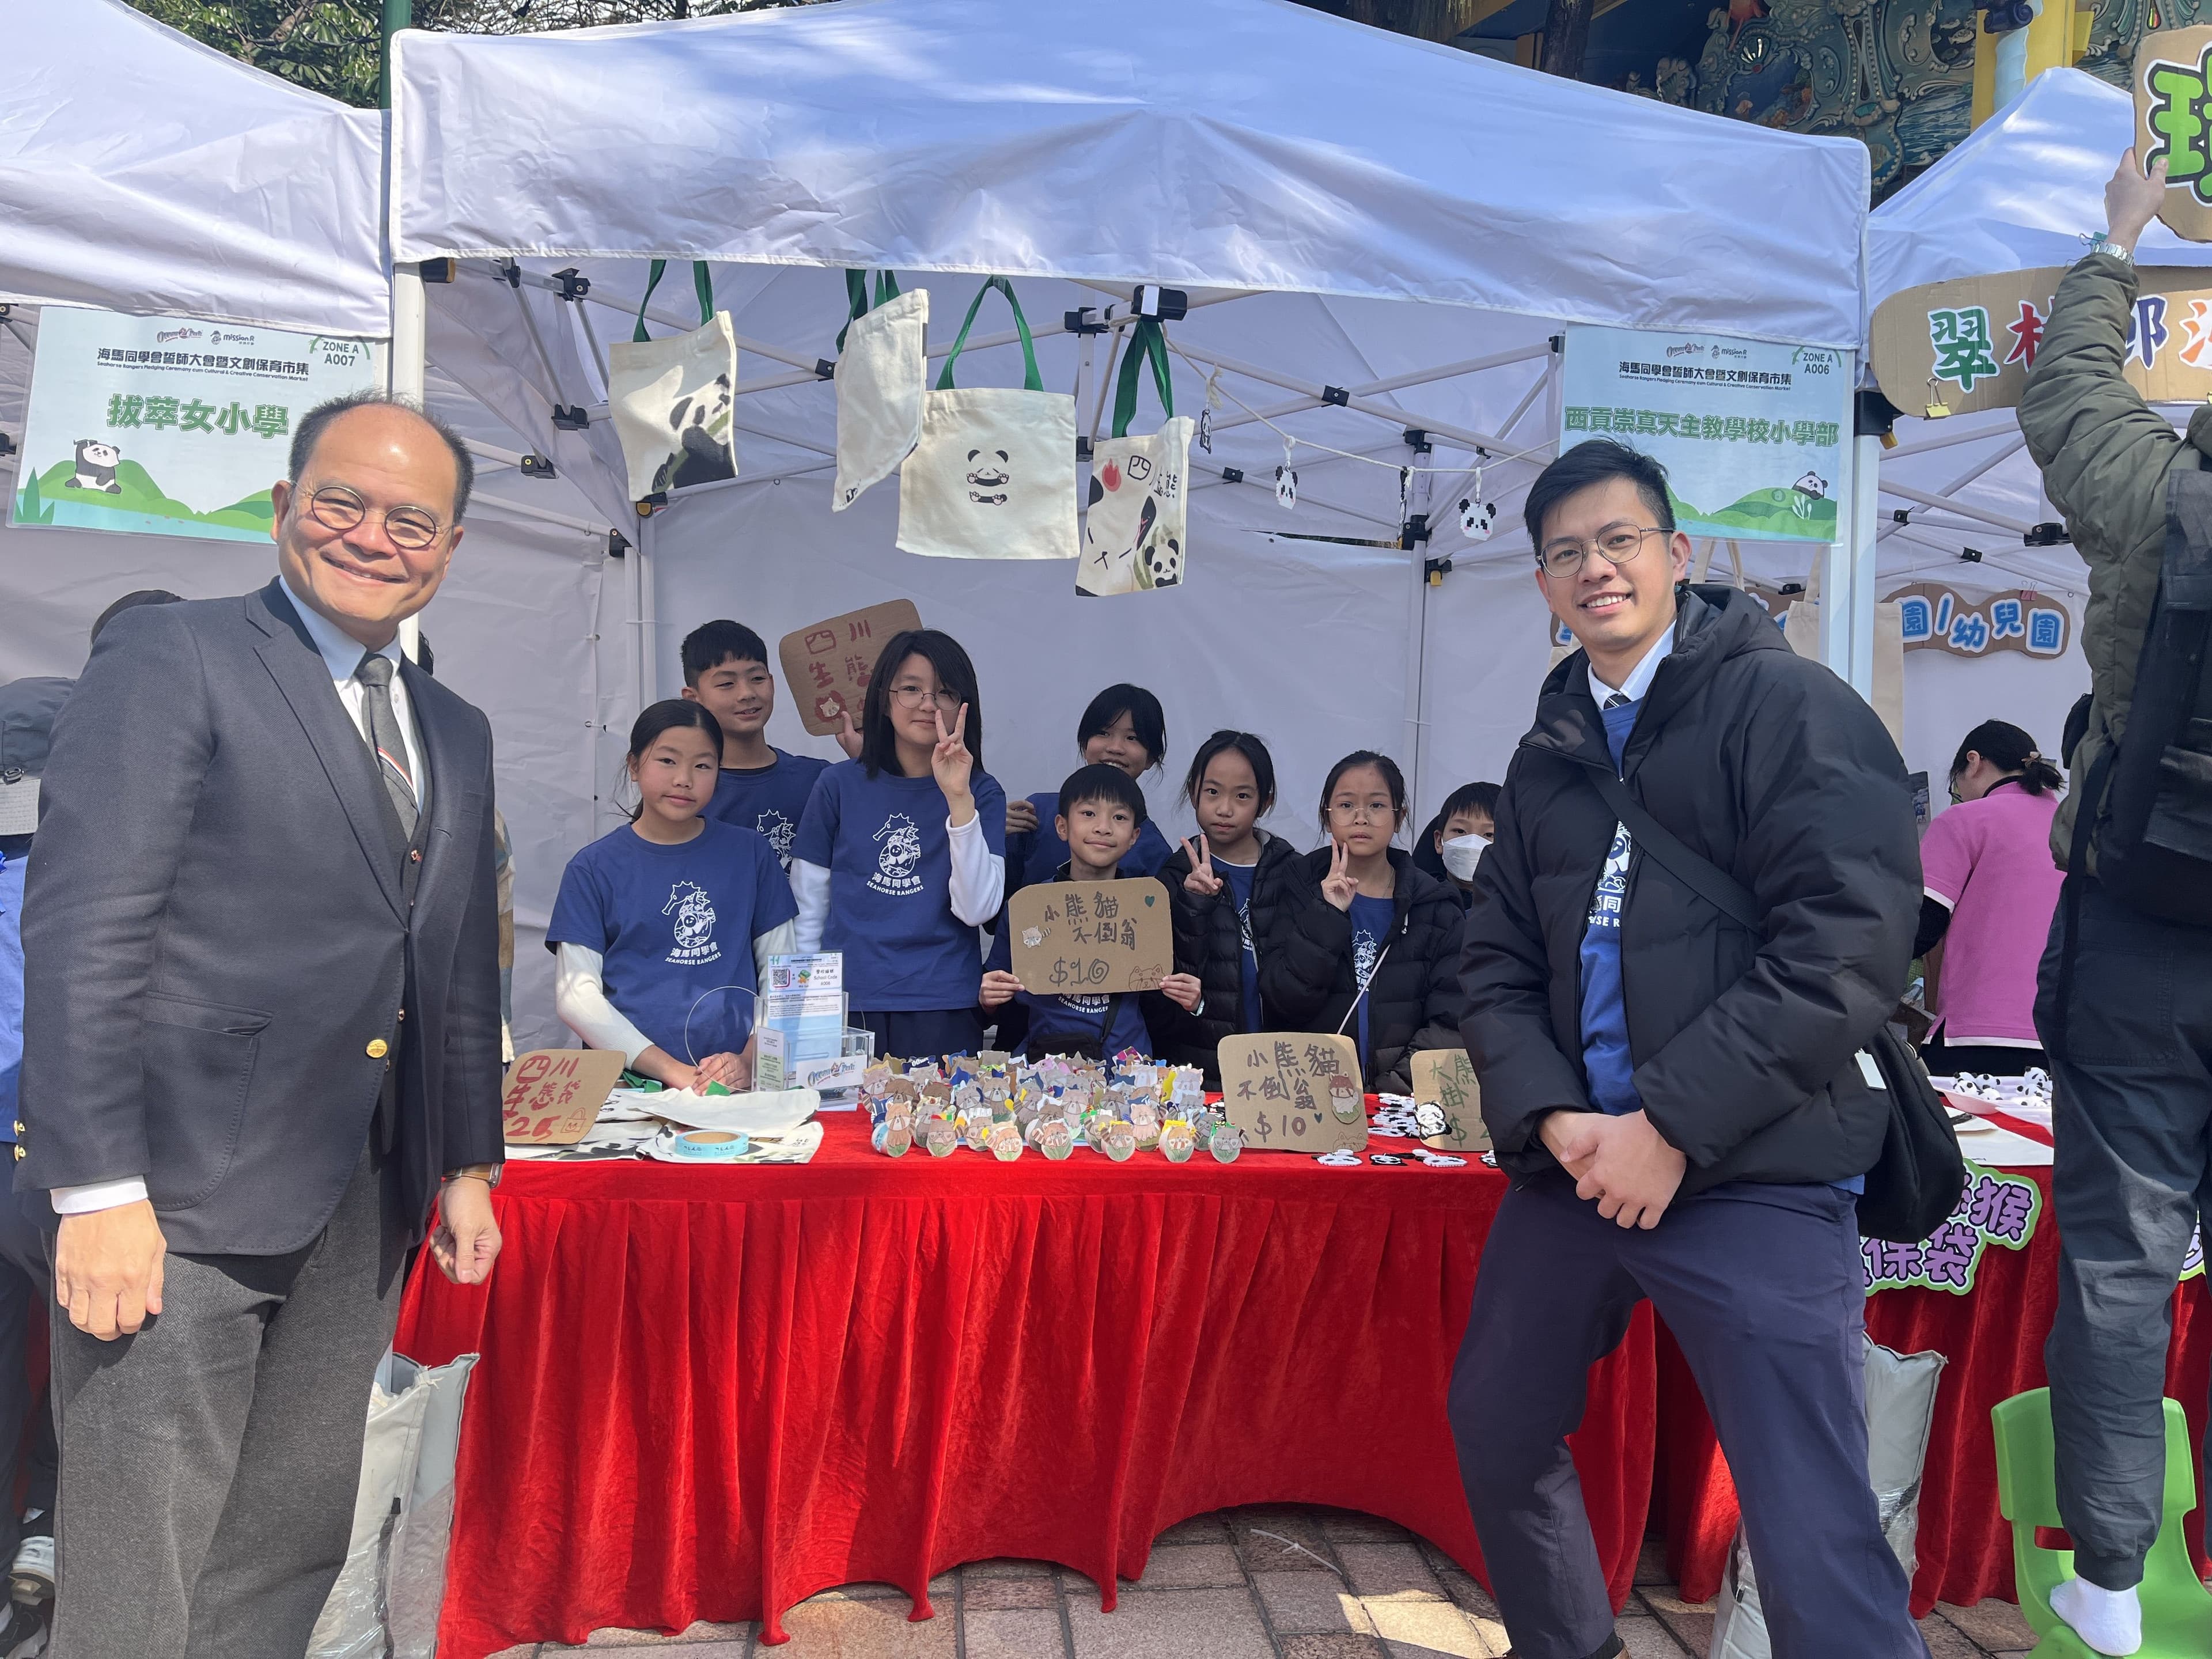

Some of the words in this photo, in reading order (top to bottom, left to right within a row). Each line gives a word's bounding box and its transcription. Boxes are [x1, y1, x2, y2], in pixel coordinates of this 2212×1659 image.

[323, 341, 350, 353] ZONE
[352, 344, 359, 354] A
[324, 353, 355, 366] A007
[1803, 353, 1825, 362] ZONE
[1827, 354, 1833, 363] A
[1804, 363, 1830, 374] A006
[107, 393, 289, 439] 拔萃女小學
[1565, 406, 1840, 448] 西貢崇真天主教學校小學部
[805, 619, 872, 654] 四川
[866, 881, 896, 896] SEAHORSE
[897, 885, 924, 896] RANGERS
[872, 872, 921, 888] 海馬同學會
[1044, 891, 1119, 926] 小熊貓
[670, 942, 718, 957] 海馬同學會
[665, 957, 696, 965] SEAHORSE
[696, 952, 722, 965] RANGERS
[1049, 956, 1110, 987] $10
[1058, 996, 1086, 1013] SEAHORSE
[1247, 1040, 1340, 1078] 小熊貓
[516, 1055, 579, 1084] 四川
[1254, 1111, 1306, 1142] $10
